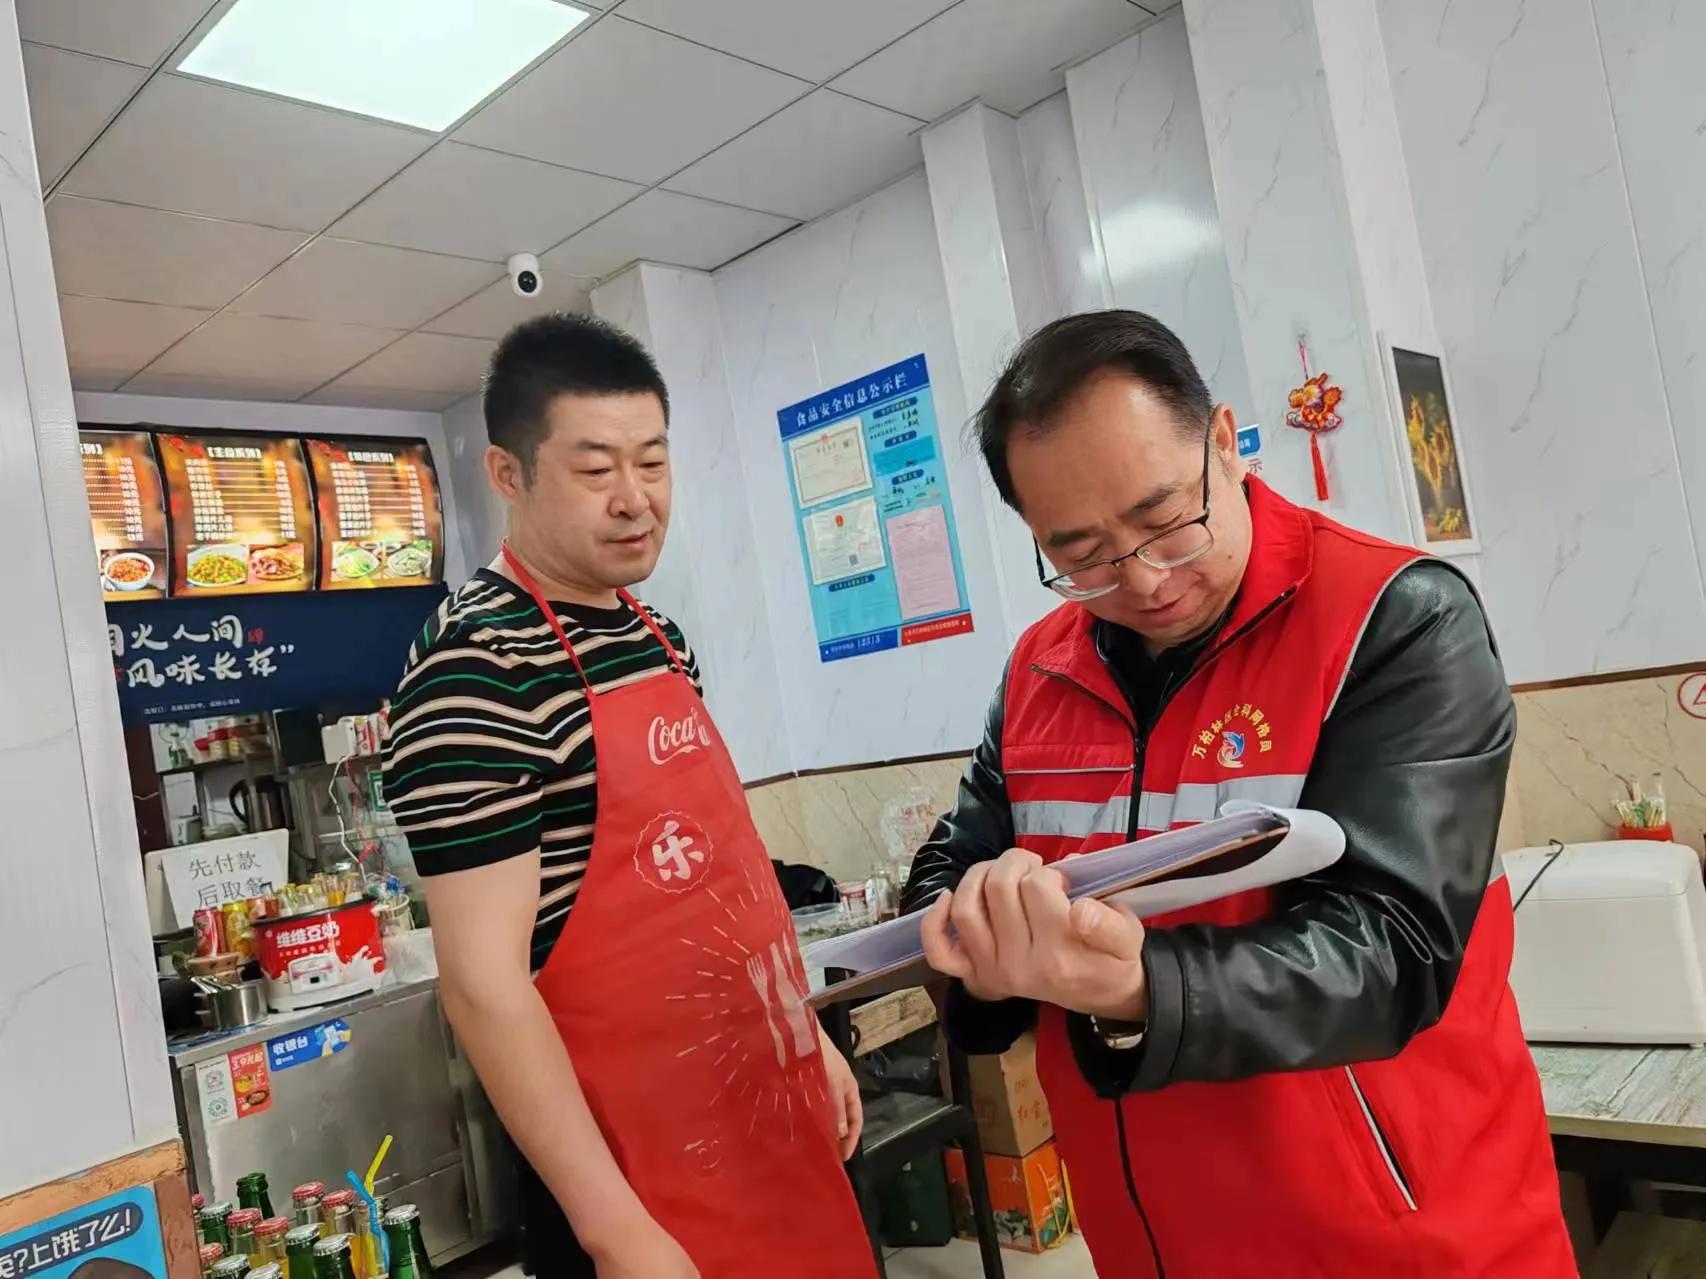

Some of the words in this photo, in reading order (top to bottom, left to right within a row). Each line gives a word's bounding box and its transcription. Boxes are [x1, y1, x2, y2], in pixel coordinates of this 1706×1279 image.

[796, 372, 908, 428] 食品安全信息公示栏
[1191, 703, 1273, 760] 万柏林区全科网格员
[188, 850, 262, 881] 先付款
[652, 820, 705, 882] 乐
[276, 921, 341, 949] 维维豆奶
[272, 1035, 310, 1055] 收银台
